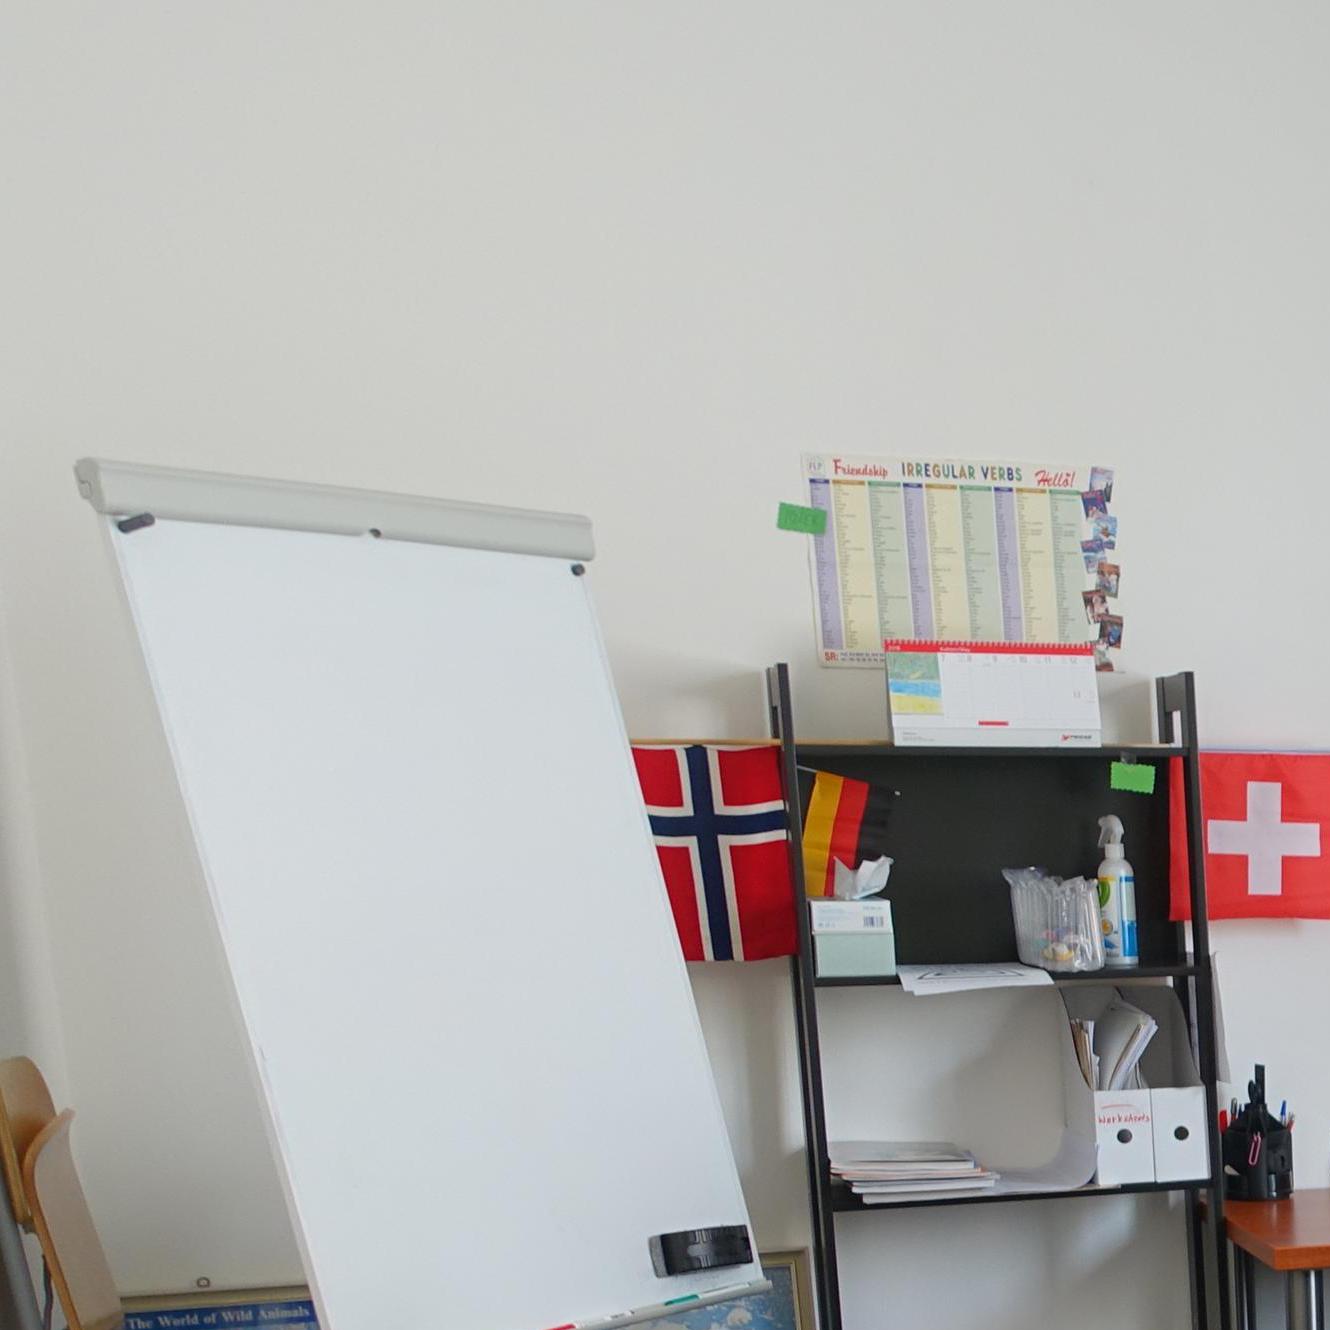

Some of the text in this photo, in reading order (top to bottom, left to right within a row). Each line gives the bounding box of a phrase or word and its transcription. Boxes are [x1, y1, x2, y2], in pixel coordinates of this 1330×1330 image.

[832, 458, 888, 479] Friendship
[901, 461, 1022, 482] IRREGULAR VERBS
[1035, 469, 1077, 488] Hello!
[127, 1305, 311, 1330] The World of Wild Animals
